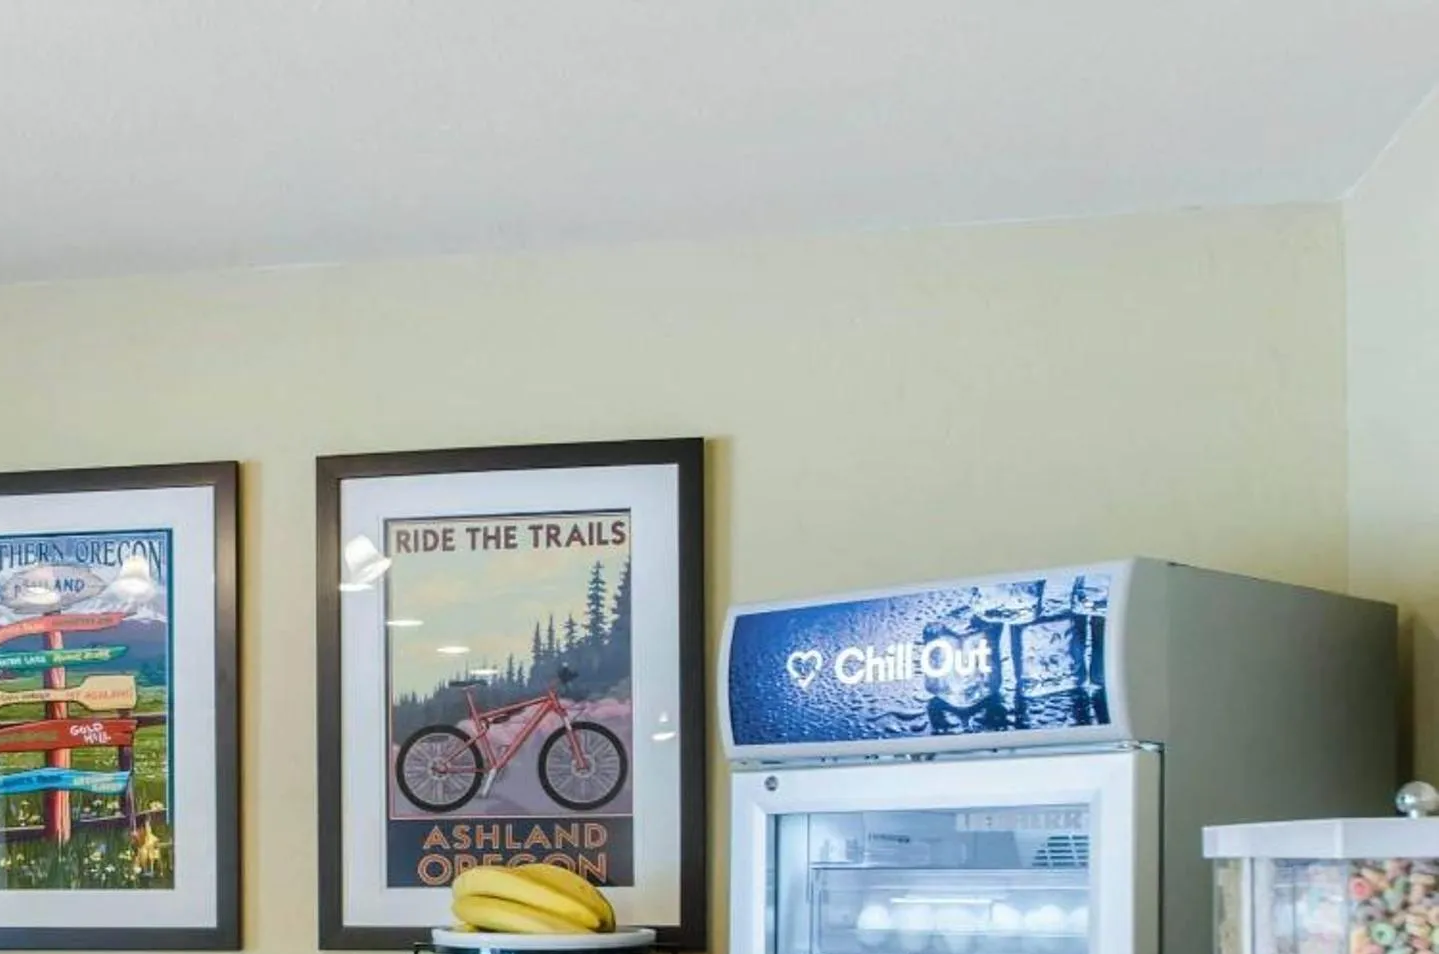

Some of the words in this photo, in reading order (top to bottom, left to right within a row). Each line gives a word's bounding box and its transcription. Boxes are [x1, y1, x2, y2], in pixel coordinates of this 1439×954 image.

[395, 528, 456, 553] RIDE
[465, 525, 519, 550] THE
[528, 521, 627, 548] TRAILS
[834, 642, 911, 685] Chill
[921, 637, 993, 678] Out
[70, 722, 104, 737] GOLD
[84, 733, 112, 744] HILL
[422, 822, 608, 850] ASHLAND
[417, 851, 608, 886] ORON
